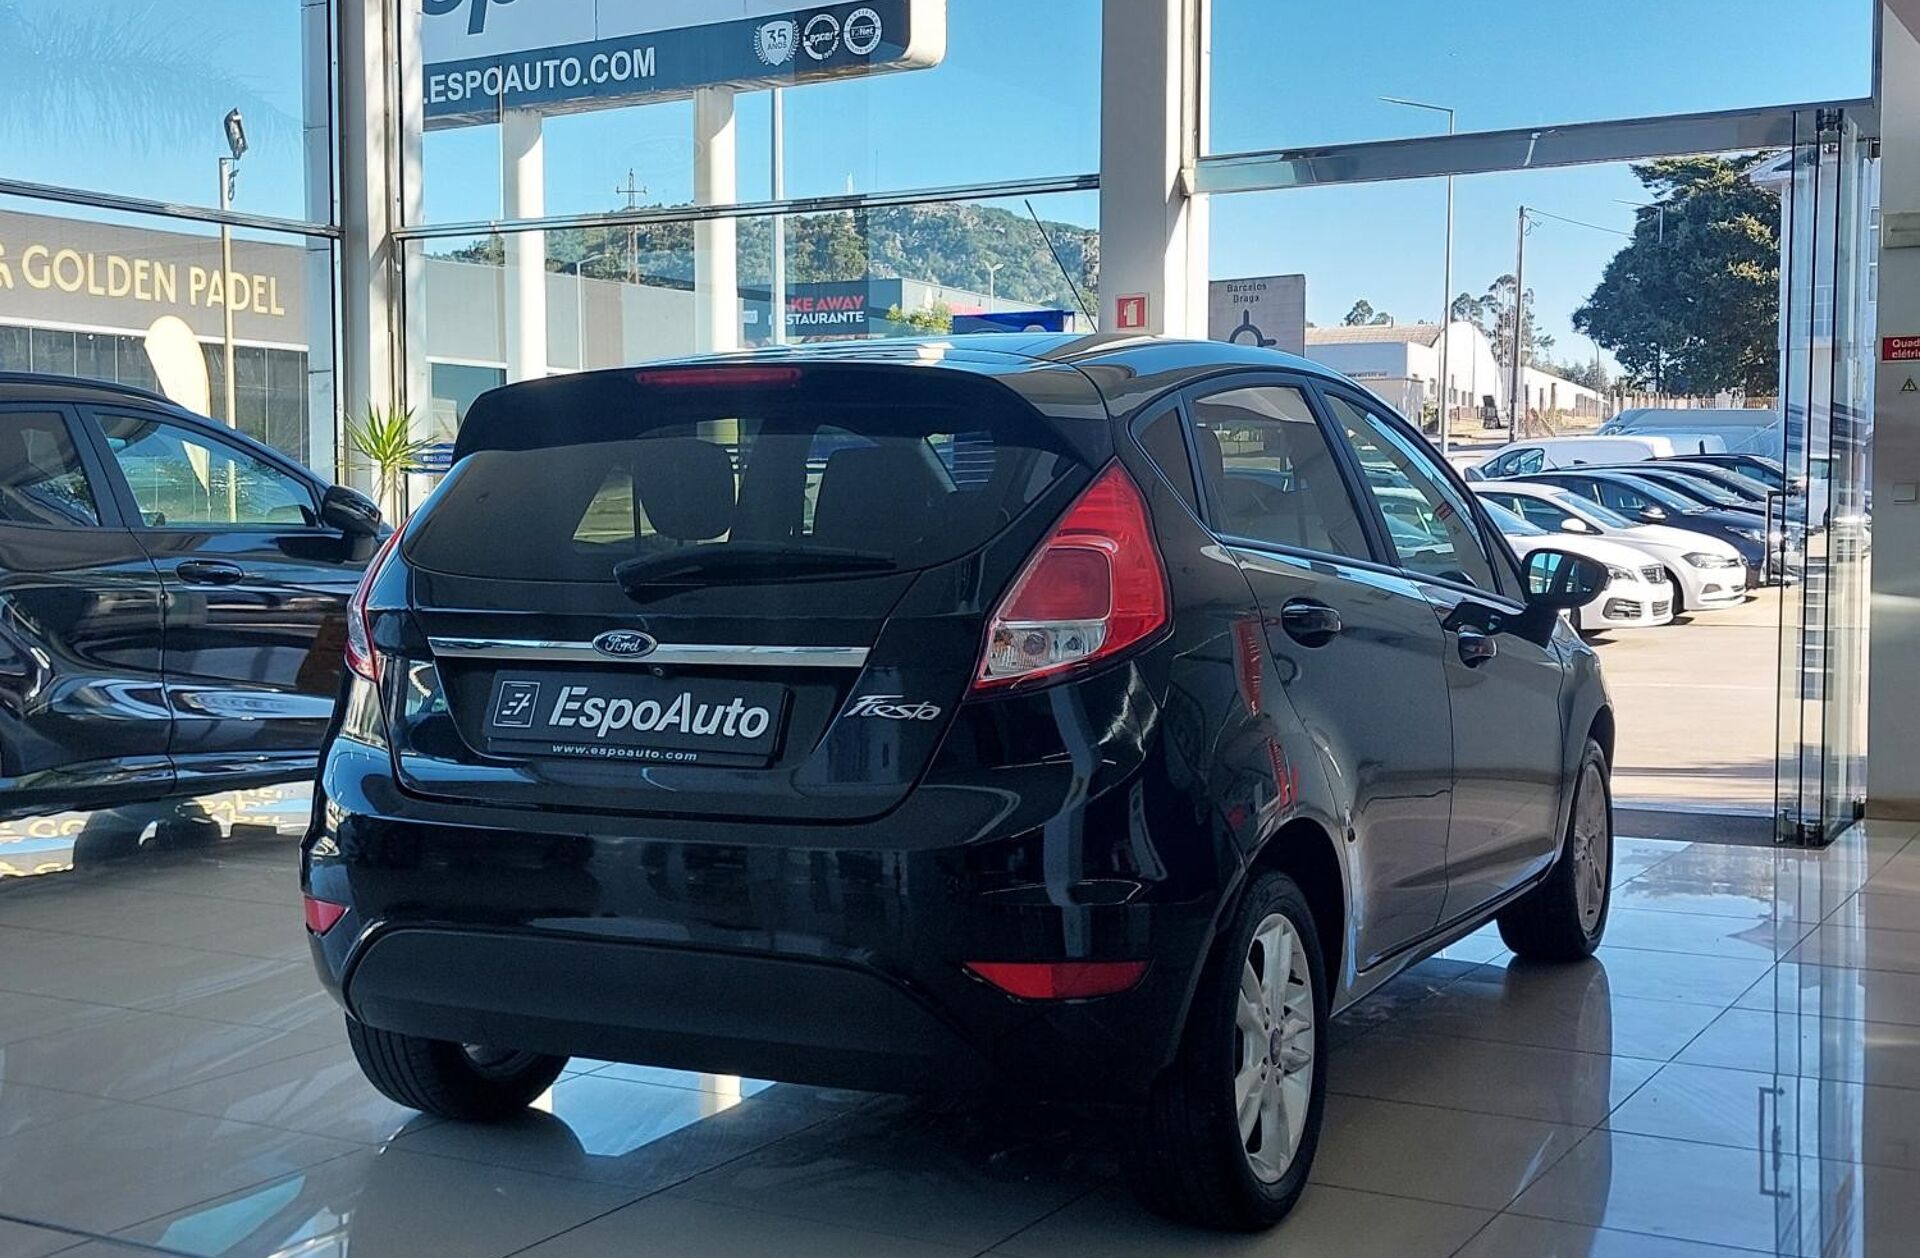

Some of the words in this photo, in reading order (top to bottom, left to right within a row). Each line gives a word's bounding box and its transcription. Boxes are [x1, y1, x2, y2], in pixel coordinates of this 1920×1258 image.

[766, 28, 787, 44] 35
[21, 244, 176, 304] GOLDEN
[189, 265, 285, 315] PADEL
[816, 295, 864, 311] AWAY
[1891, 349, 1920, 359] elétri
[604, 634, 641, 652] Ford
[548, 686, 770, 739] EspoAuto
[843, 694, 941, 720] Fiesta
[551, 744, 697, 762] www.espoauto.com
